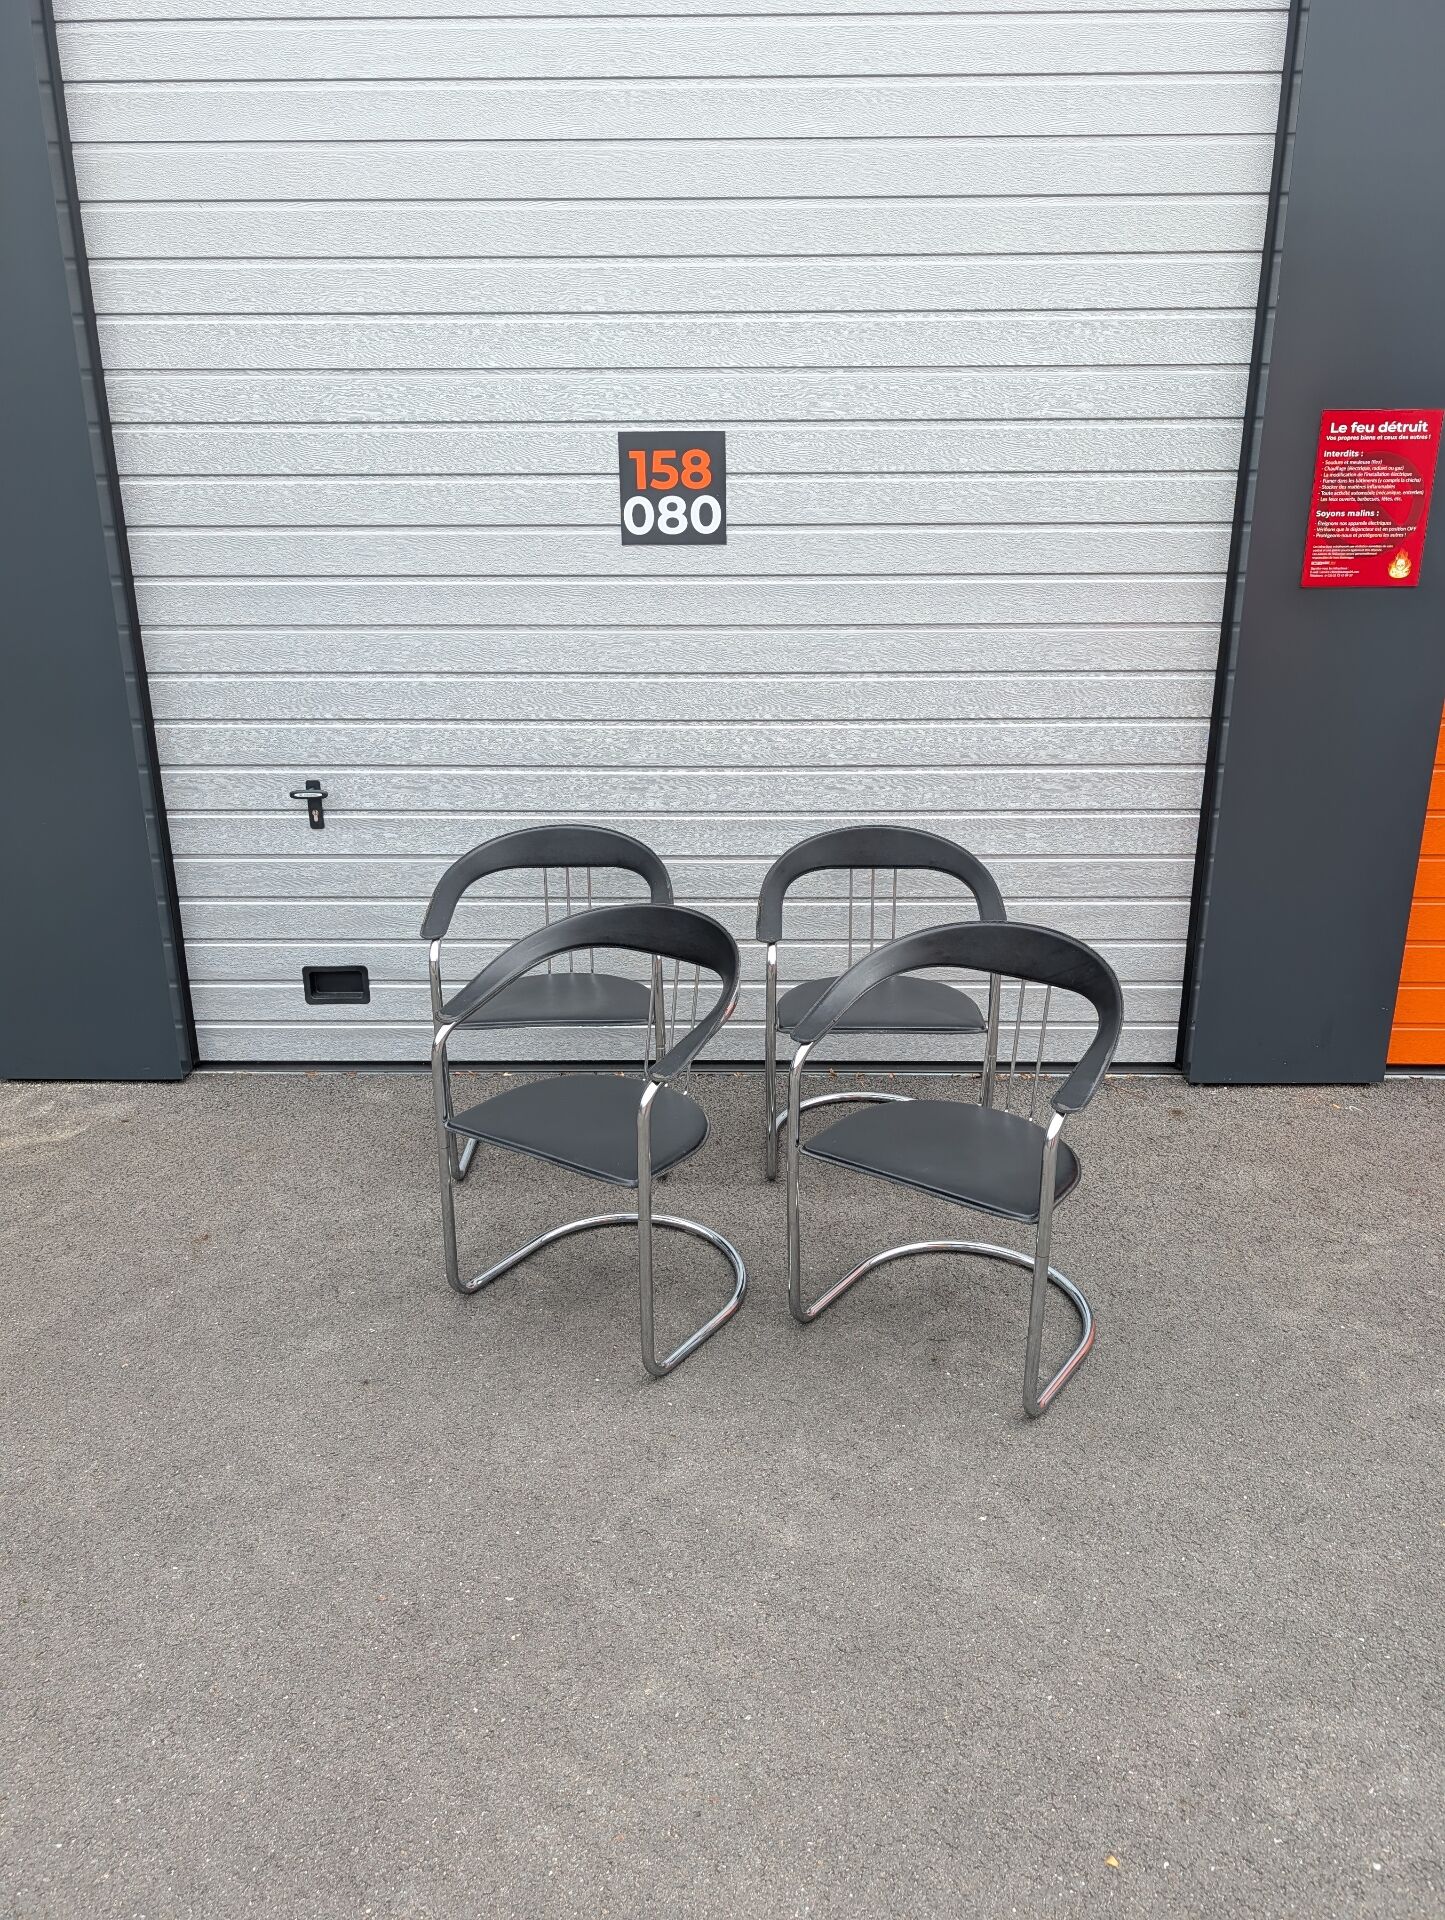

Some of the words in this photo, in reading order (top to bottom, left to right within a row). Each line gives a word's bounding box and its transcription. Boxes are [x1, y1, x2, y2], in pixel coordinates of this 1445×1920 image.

[1330, 422, 1347, 433] Le
[1351, 422, 1374, 433] feu
[1378, 421, 1428, 432] détruit
[628, 448, 712, 490] 158
[624, 495, 721, 535] 080
